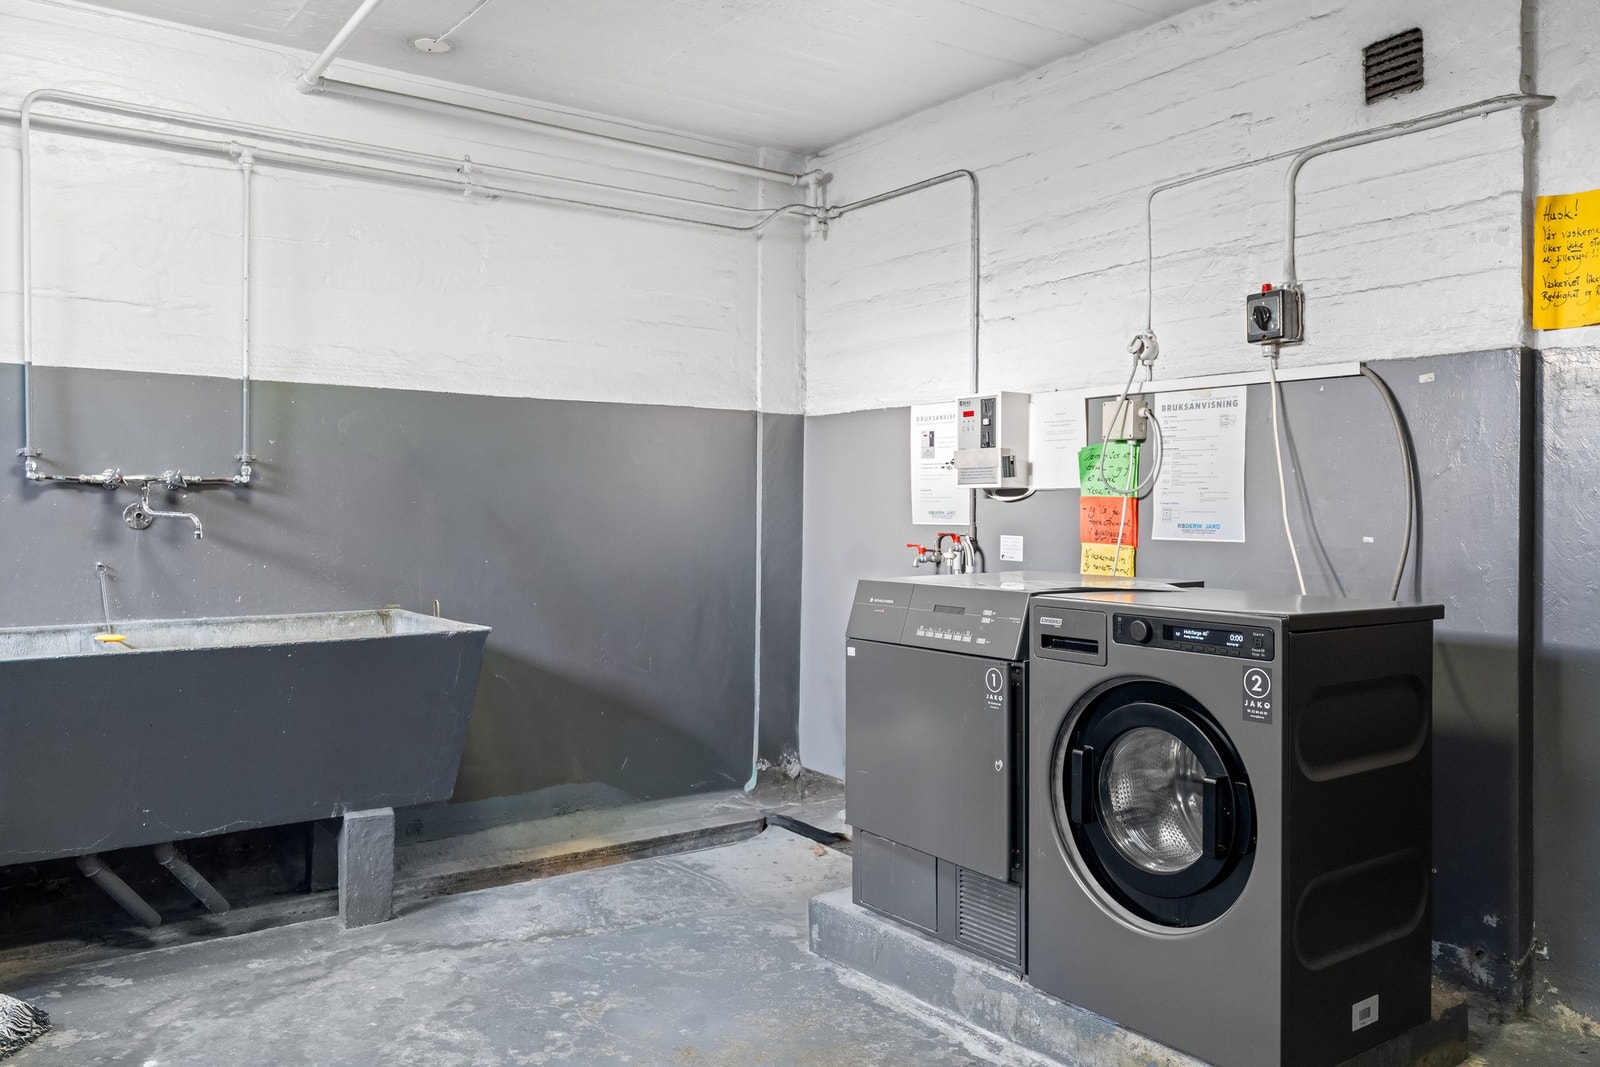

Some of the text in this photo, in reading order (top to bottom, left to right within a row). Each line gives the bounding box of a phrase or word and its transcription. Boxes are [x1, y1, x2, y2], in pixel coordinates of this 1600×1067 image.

[1543, 199, 1579, 222] Husk!
[1161, 399, 1239, 412] BRUKSANVISNING
[991, 673, 997, 688] 1
[1251, 674, 1263, 692] 2
[1244, 699, 1271, 709] JAKO
